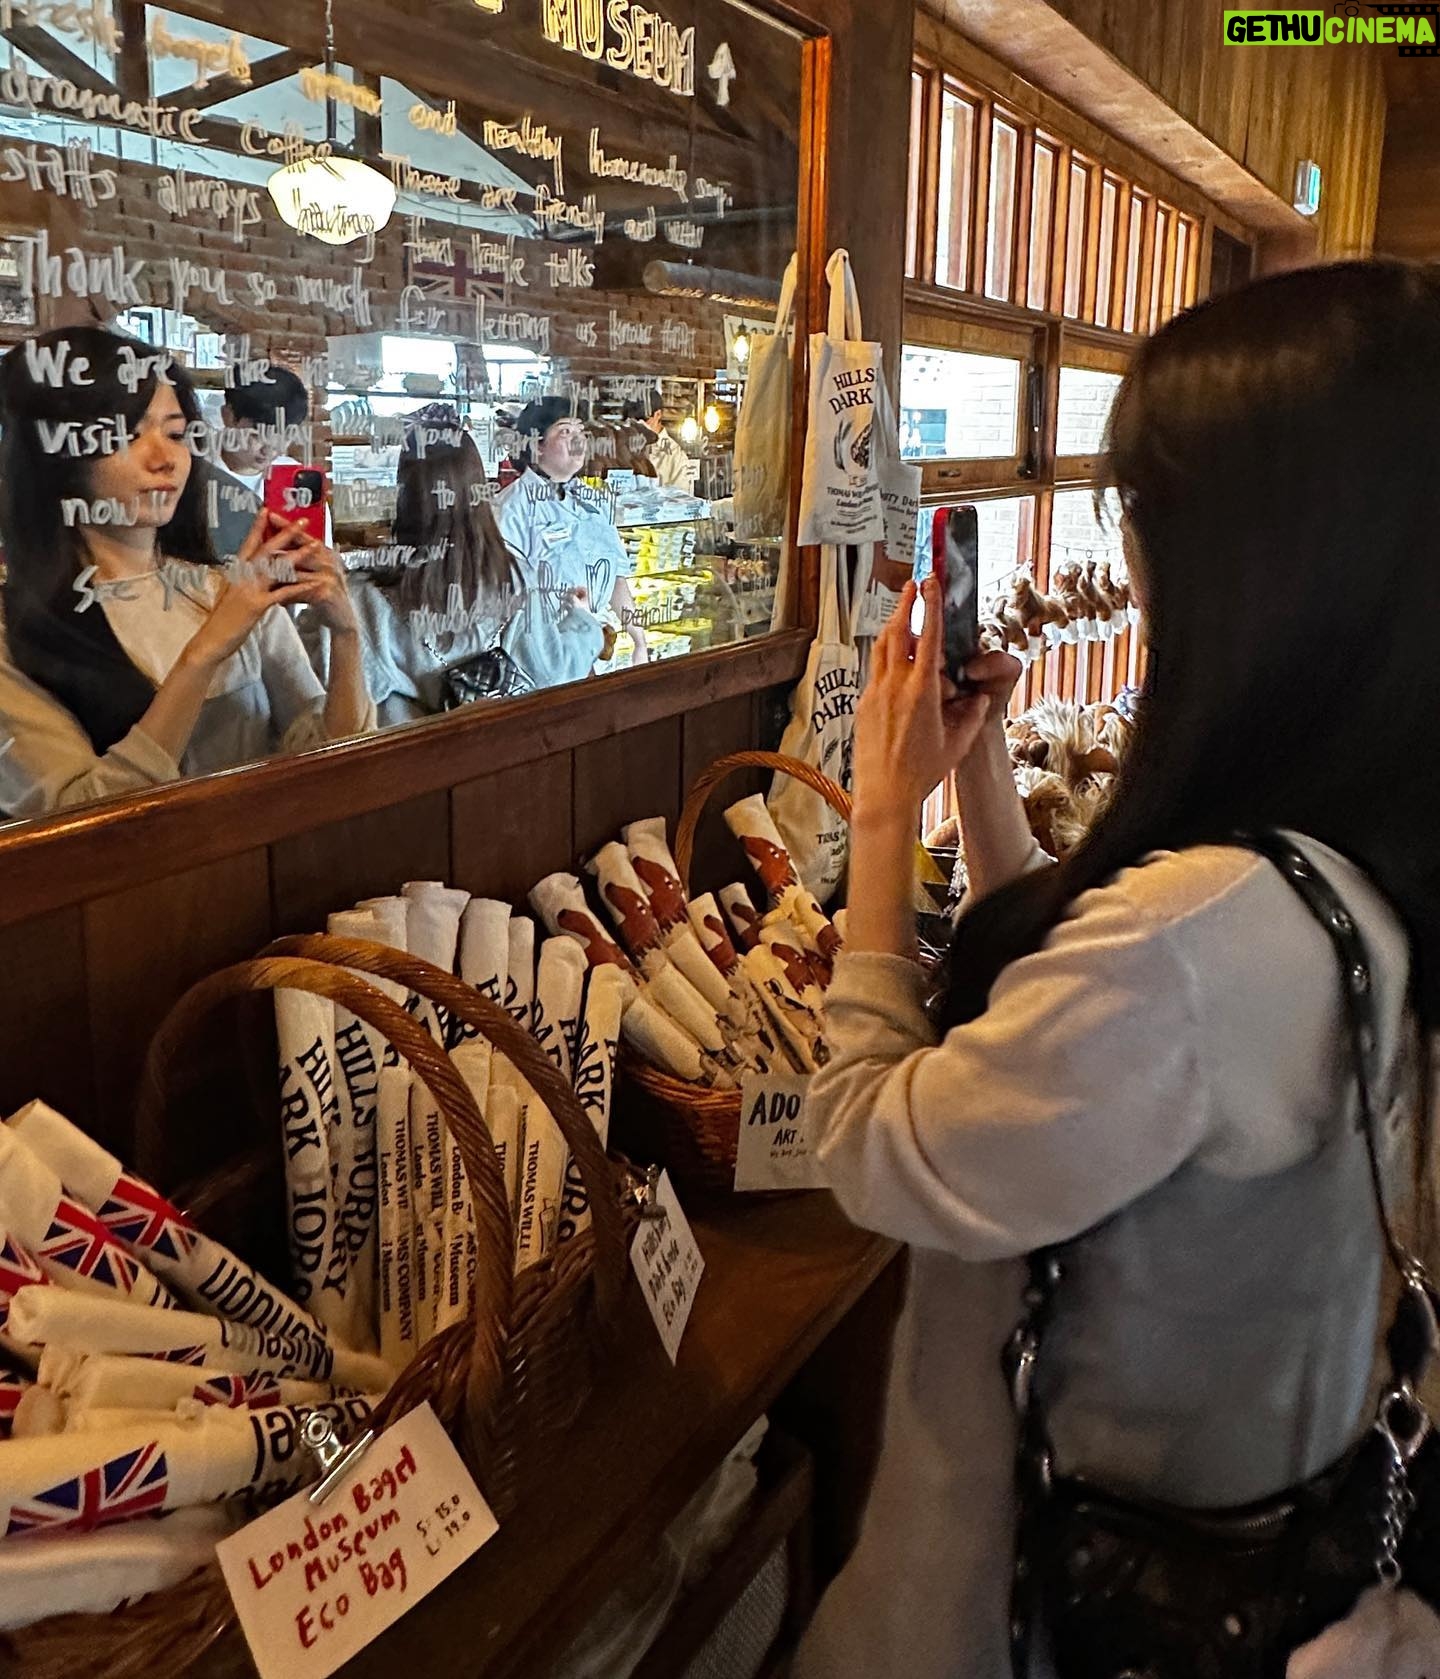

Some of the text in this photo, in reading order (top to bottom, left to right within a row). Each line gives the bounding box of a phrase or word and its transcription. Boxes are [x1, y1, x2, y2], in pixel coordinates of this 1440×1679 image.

[541, 0, 696, 97] MUSEUM
[156, 164, 262, 243] always
[544, 247, 597, 288] talks
[623, 205, 657, 242] and
[10, 229, 146, 304] Thank
[169, 256, 234, 319] you
[247, 271, 278, 306] so
[295, 266, 374, 326] much
[574, 320, 599, 348] us
[607, 308, 653, 352] know
[24, 339, 95, 388] We
[116, 345, 177, 394] are
[832, 367, 875, 391] HILLS
[828, 388, 874, 415] DARK
[186, 406, 313, 468] everyday
[282, 486, 313, 513] so
[425, 1110, 442, 1178] THOMAS
[522, 1140, 540, 1204] THOMAS
[247, 1512, 349, 1590] London
[303, 1508, 401, 1593] Museum
[358, 1546, 409, 1597] Bag
